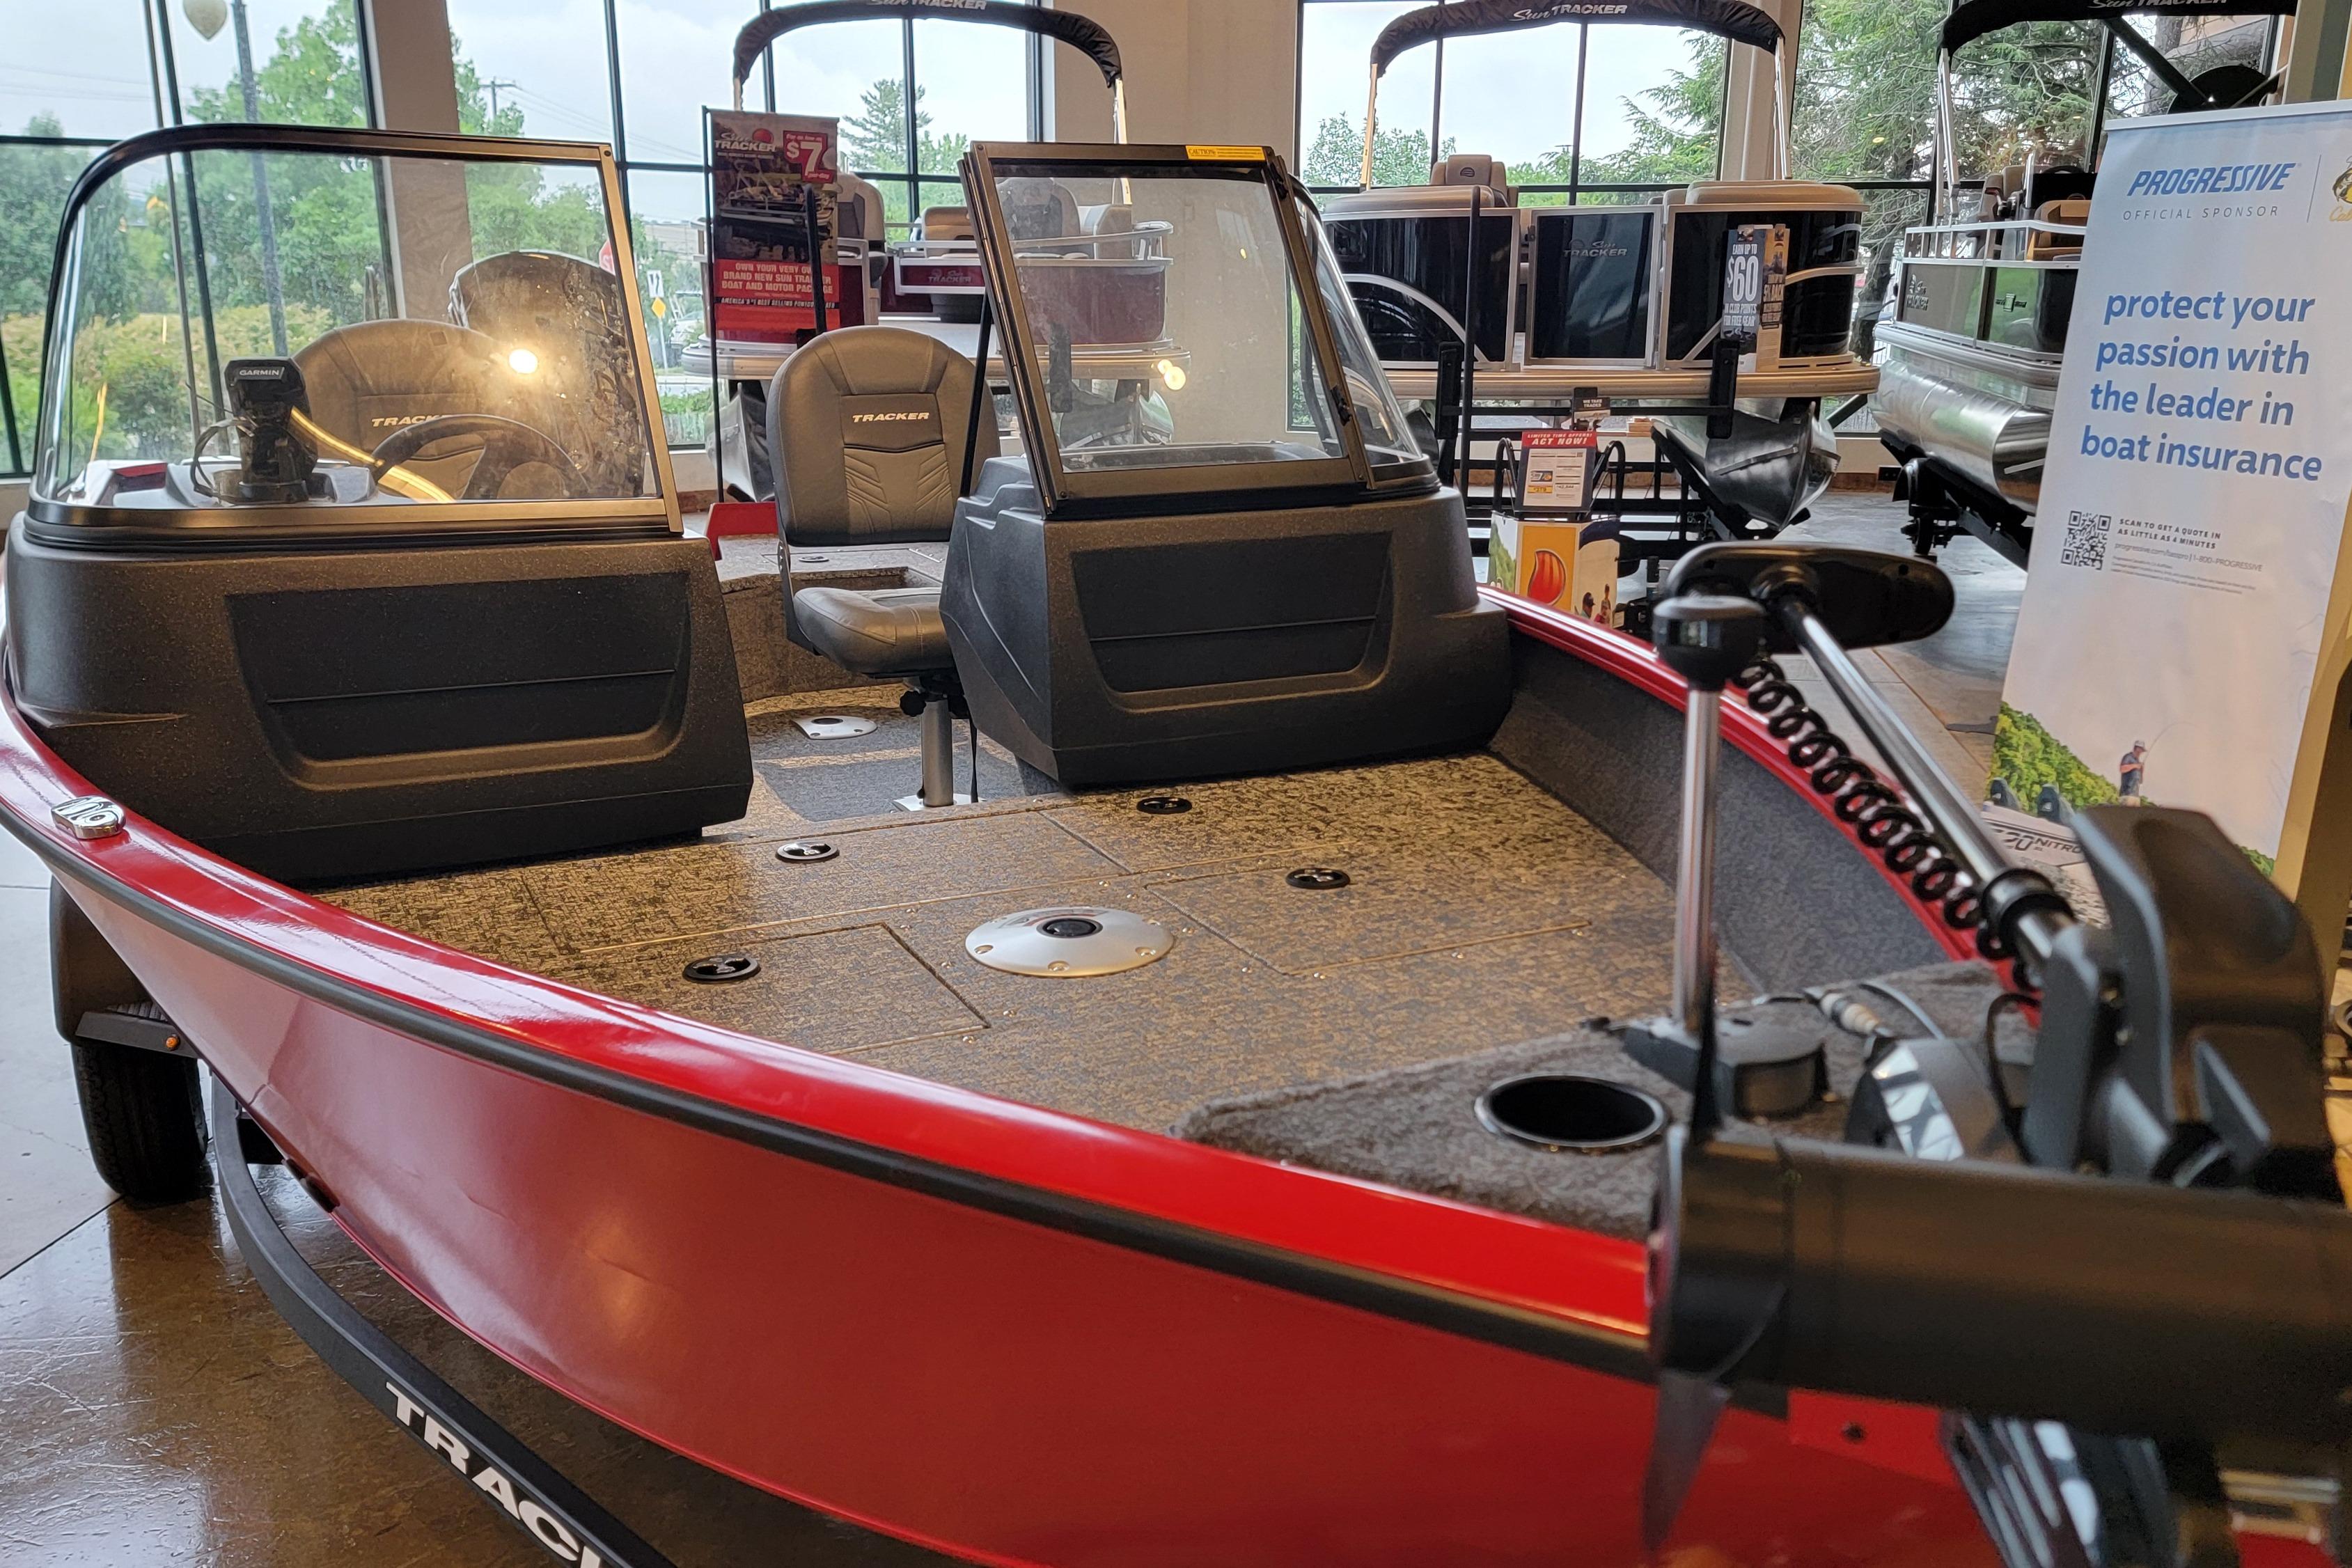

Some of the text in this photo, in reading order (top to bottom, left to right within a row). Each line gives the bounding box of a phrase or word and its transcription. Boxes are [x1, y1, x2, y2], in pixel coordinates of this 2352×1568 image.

[1510, 4, 1628, 21] Sun TRACKER
[714, 140, 776, 152] TRACKER
[786, 140, 822, 176] $7
[2126, 162, 2296, 196] PROGRESSIVE
[2123, 206, 2278, 221] OFFICIAL SPONSOR
[1562, 248, 1627, 257] TRACKER
[1732, 244, 1744, 255] EARN
[735, 262, 754, 272] OWN
[757, 264, 776, 272] YOUR
[779, 265, 799, 274] VERY
[723, 271, 831, 284] BRAND NEW SUN TRAER
[1727, 255, 1759, 301] $60
[721, 280, 833, 294] BOAT AND MOTOR PACGE
[1729, 304, 1740, 313] CLUB
[1740, 304, 1757, 313] POINTS
[2103, 290, 2315, 329] protect your
[1731, 315, 1742, 327] FREE
[1742, 315, 1755, 327] GEAR
[2095, 336, 2310, 375] passion with
[2091, 380, 2294, 426] the leader in
[371, 415, 440, 428] TRACK
[852, 412, 930, 423] TRACKER
[2080, 425, 2323, 481] boat insurance
[2119, 519, 2142, 527] SCAN
[2181, 528, 2208, 538] QUOTE
[2131, 530, 2158, 540] LITTLE
[2179, 538, 2216, 549] MINUTES
[2193, 554, 2262, 572] 1-800-PROGRESSIVE
